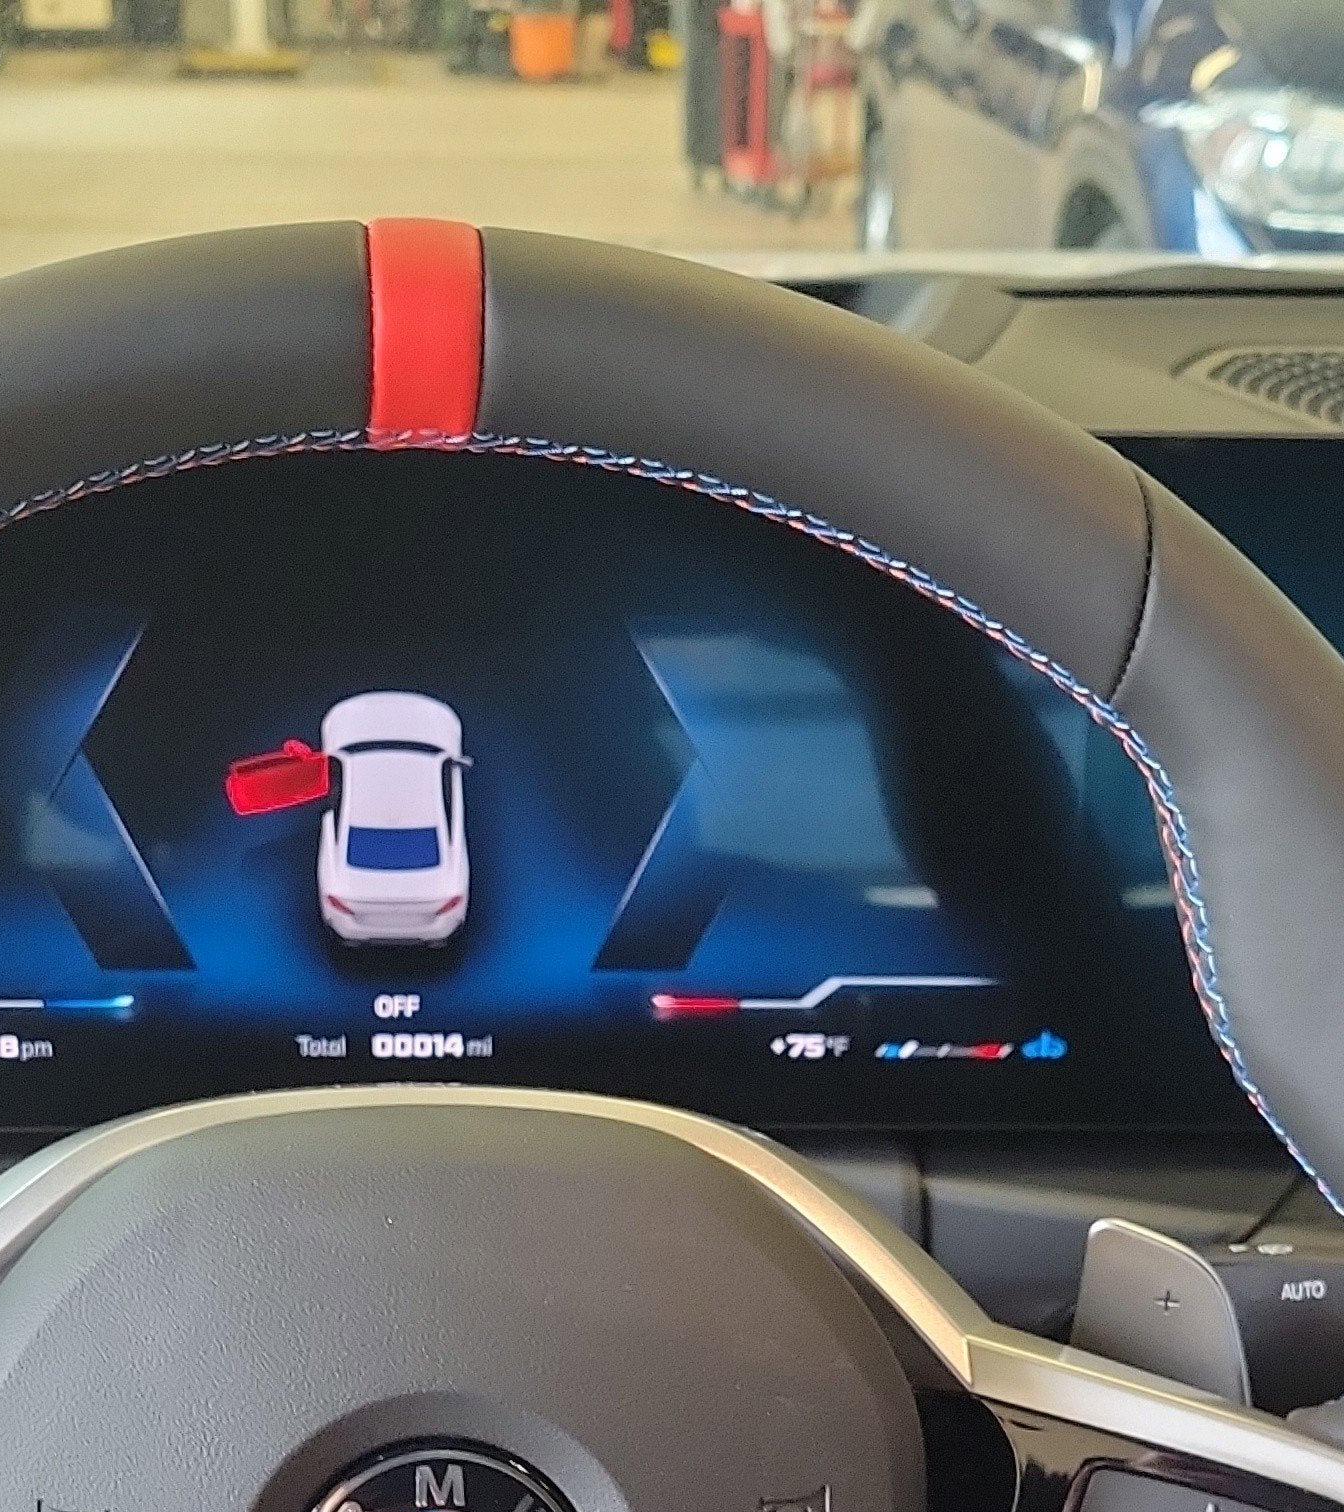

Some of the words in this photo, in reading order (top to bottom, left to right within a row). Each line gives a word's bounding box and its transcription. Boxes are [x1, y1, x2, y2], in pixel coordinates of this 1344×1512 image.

[374, 994, 421, 1018] OFF
[296, 1034, 347, 1058] Total
[371, 1032, 465, 1058] 00014
[1281, 1280, 1327, 1300] AUTO
